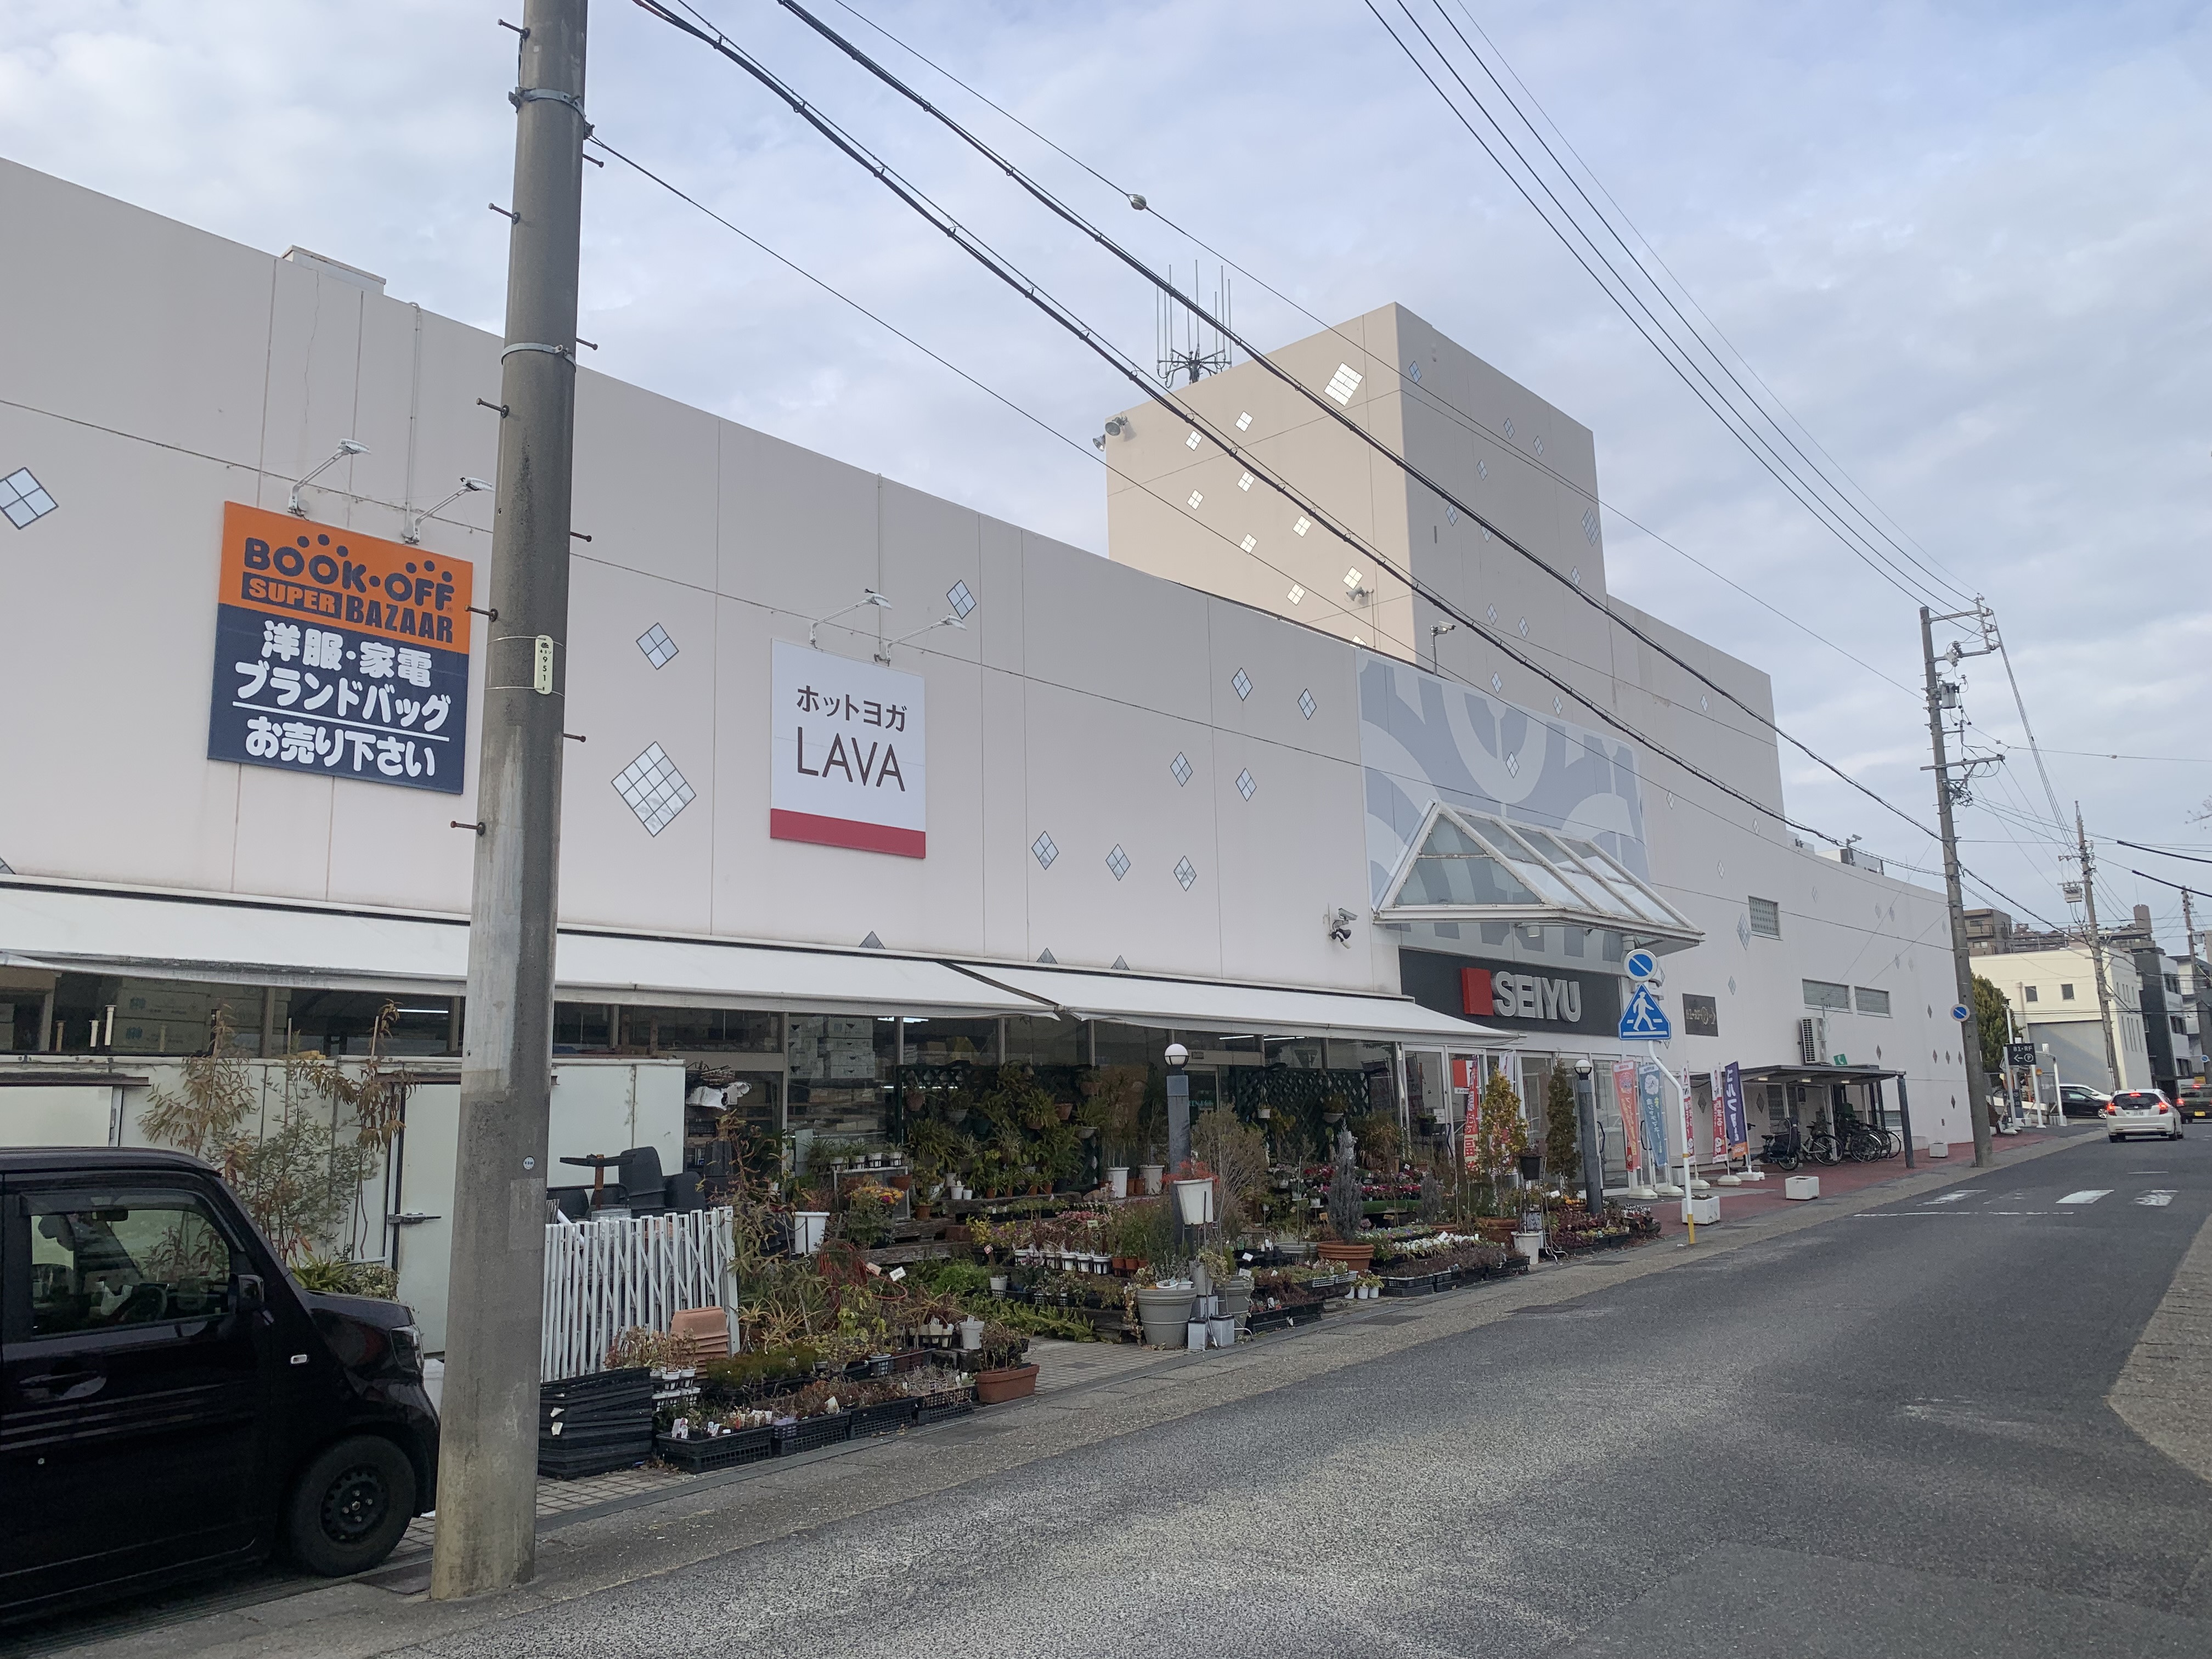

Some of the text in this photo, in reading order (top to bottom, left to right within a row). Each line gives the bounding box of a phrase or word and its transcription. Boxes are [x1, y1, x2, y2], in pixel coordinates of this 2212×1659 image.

[249, 579, 453, 644] SUPER BAZAAR
[261, 620, 432, 688] 洋服・家電
[235, 660, 451, 733] ブランドバッグ
[797, 685, 907, 732] ホットヨガ
[245, 716, 435, 777] お売り下さい
[798, 726, 906, 792] LAVA
[1495, 971, 1582, 1022] SEIYU
